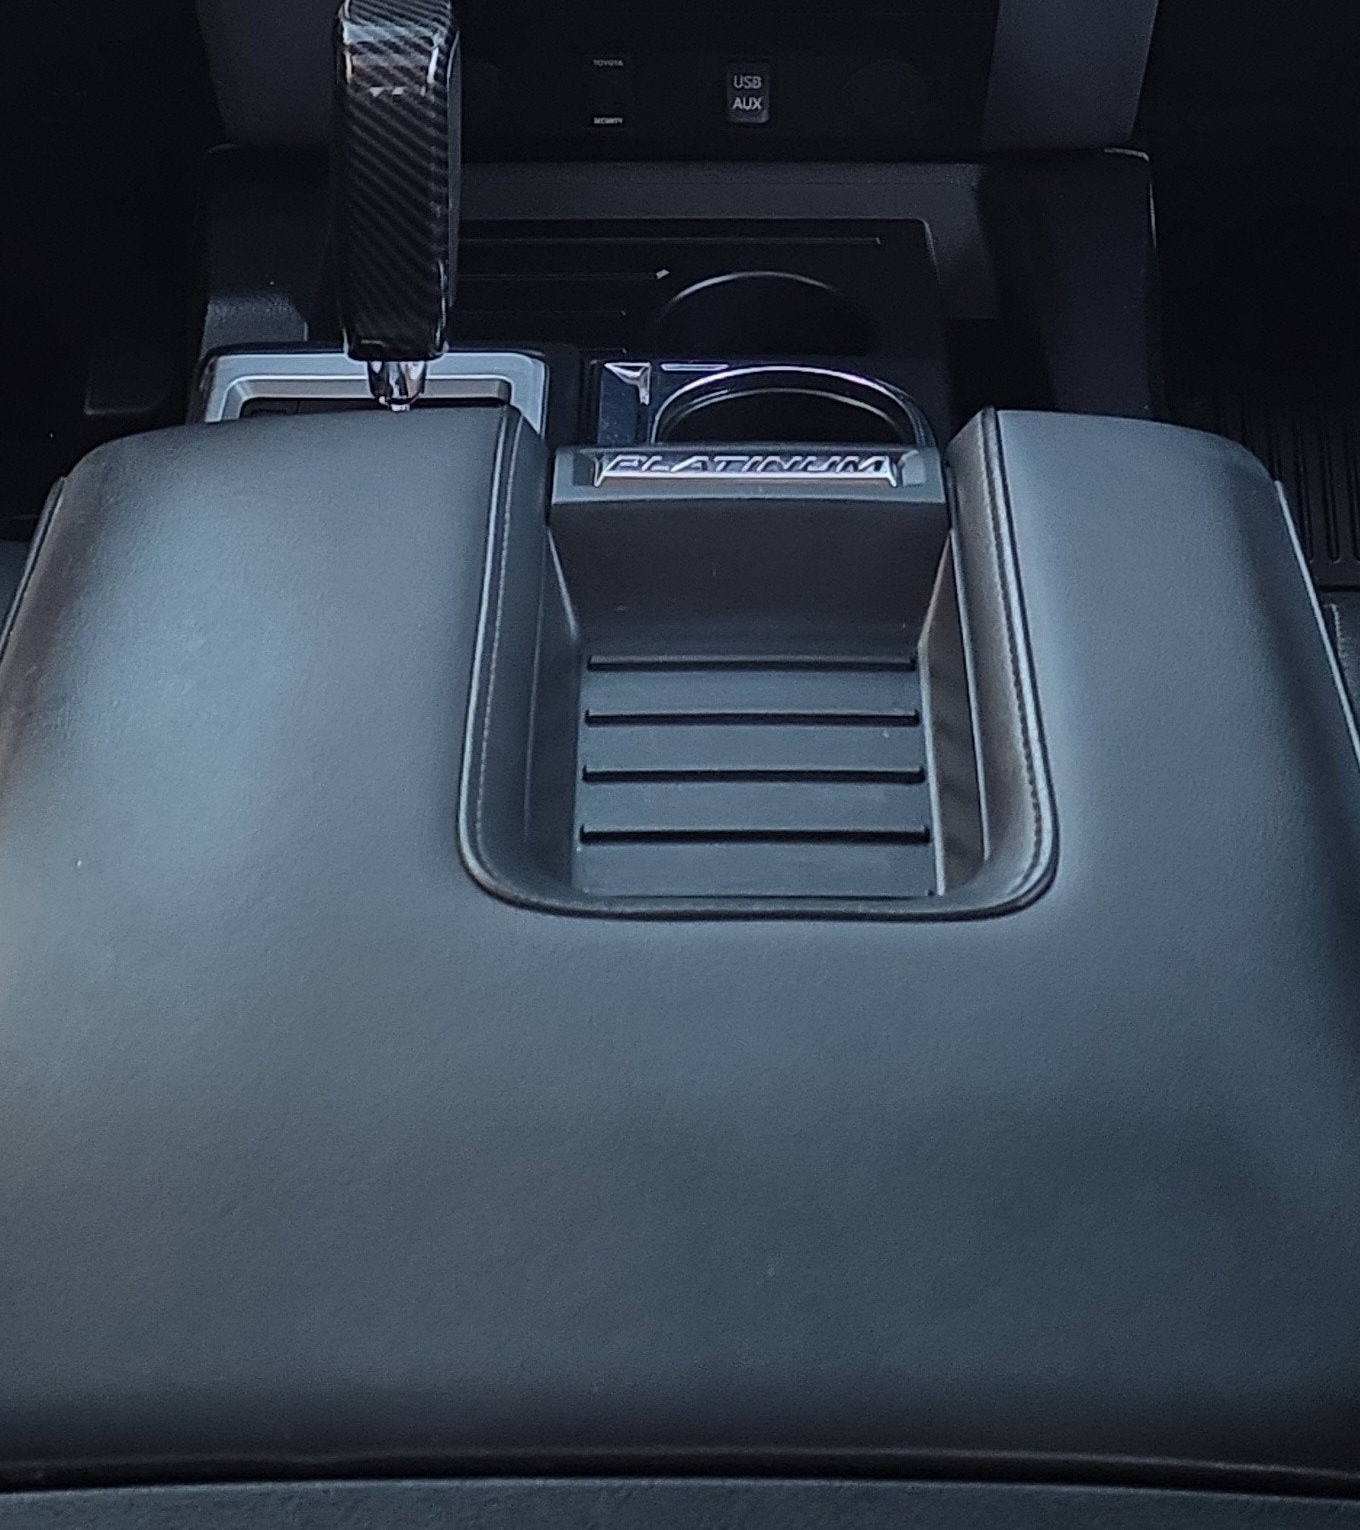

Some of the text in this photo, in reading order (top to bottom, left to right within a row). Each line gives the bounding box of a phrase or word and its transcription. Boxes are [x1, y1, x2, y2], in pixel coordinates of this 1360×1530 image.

[733, 75, 762, 89] USB
[732, 97, 762, 110] AUX
[602, 455, 892, 474] PLATINUM
